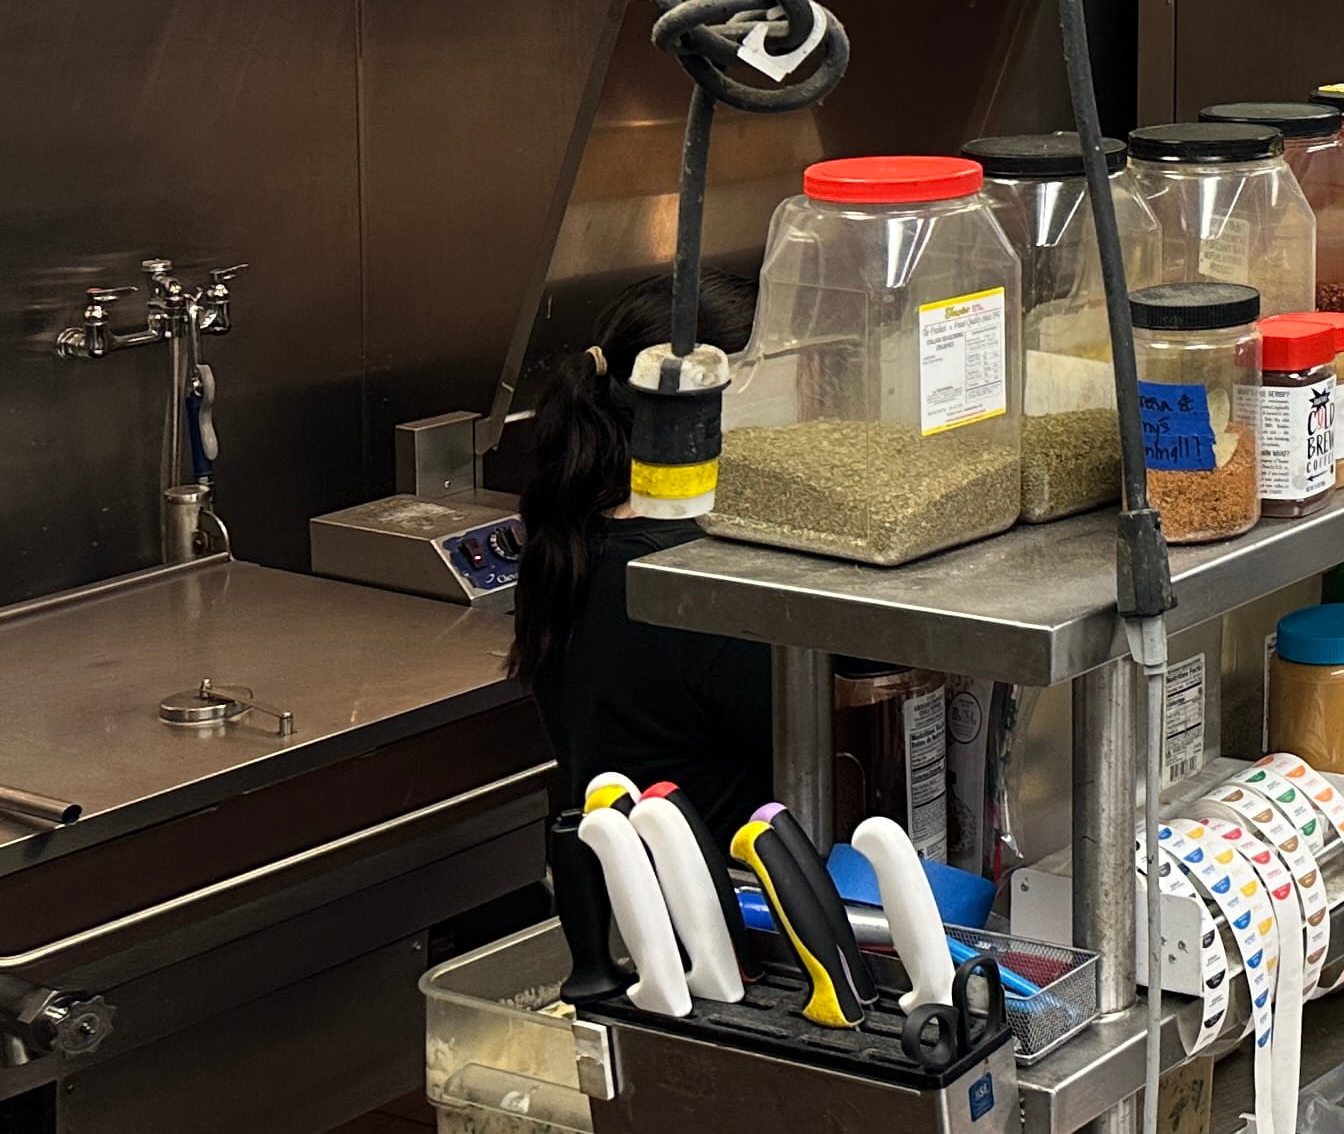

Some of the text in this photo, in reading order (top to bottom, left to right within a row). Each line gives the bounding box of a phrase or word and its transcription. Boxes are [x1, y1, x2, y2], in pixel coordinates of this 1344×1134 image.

[1308, 402, 1336, 436] COLD
[1306, 430, 1335, 460] BREW
[1306, 449, 1335, 474] COFFEE
